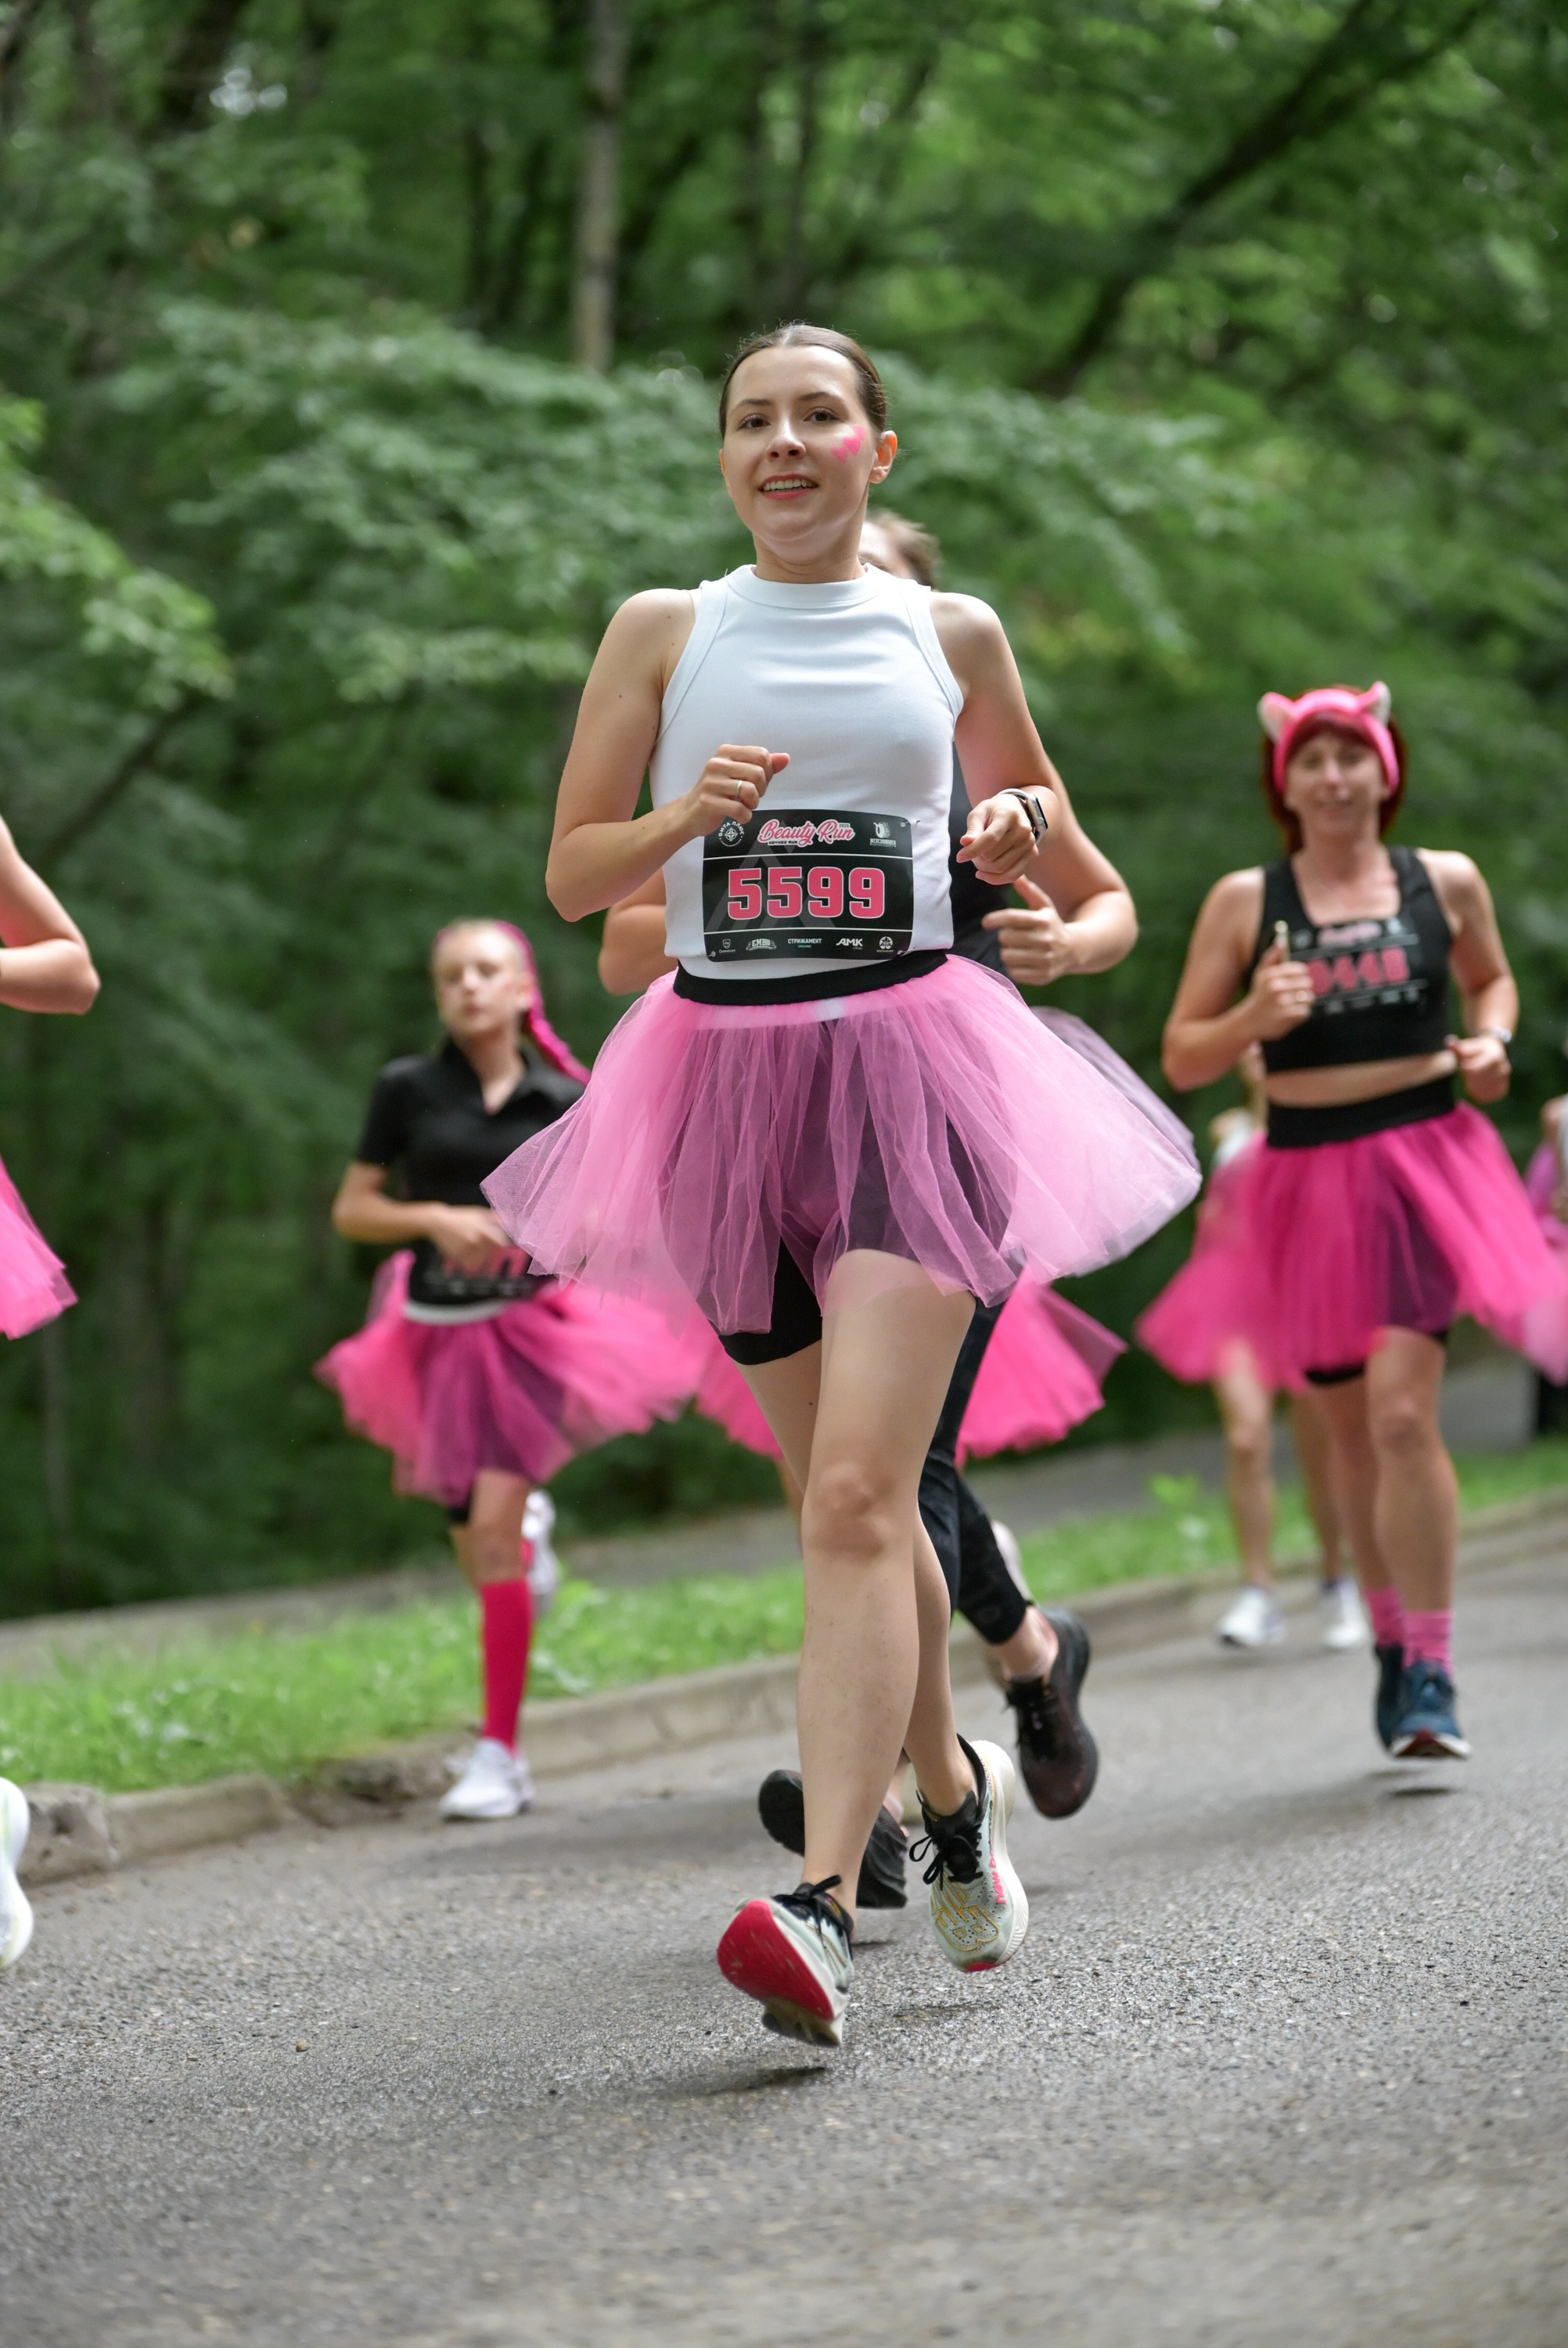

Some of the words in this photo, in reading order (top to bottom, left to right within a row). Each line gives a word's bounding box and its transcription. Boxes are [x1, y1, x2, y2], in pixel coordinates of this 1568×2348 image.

[718, 822, 731, 837] ВИТА
[732, 820, 745, 835] ПЛЮС
[758, 819, 815, 847] Beauty
[818, 819, 855, 843] Run
[728, 866, 885, 920] 5599
